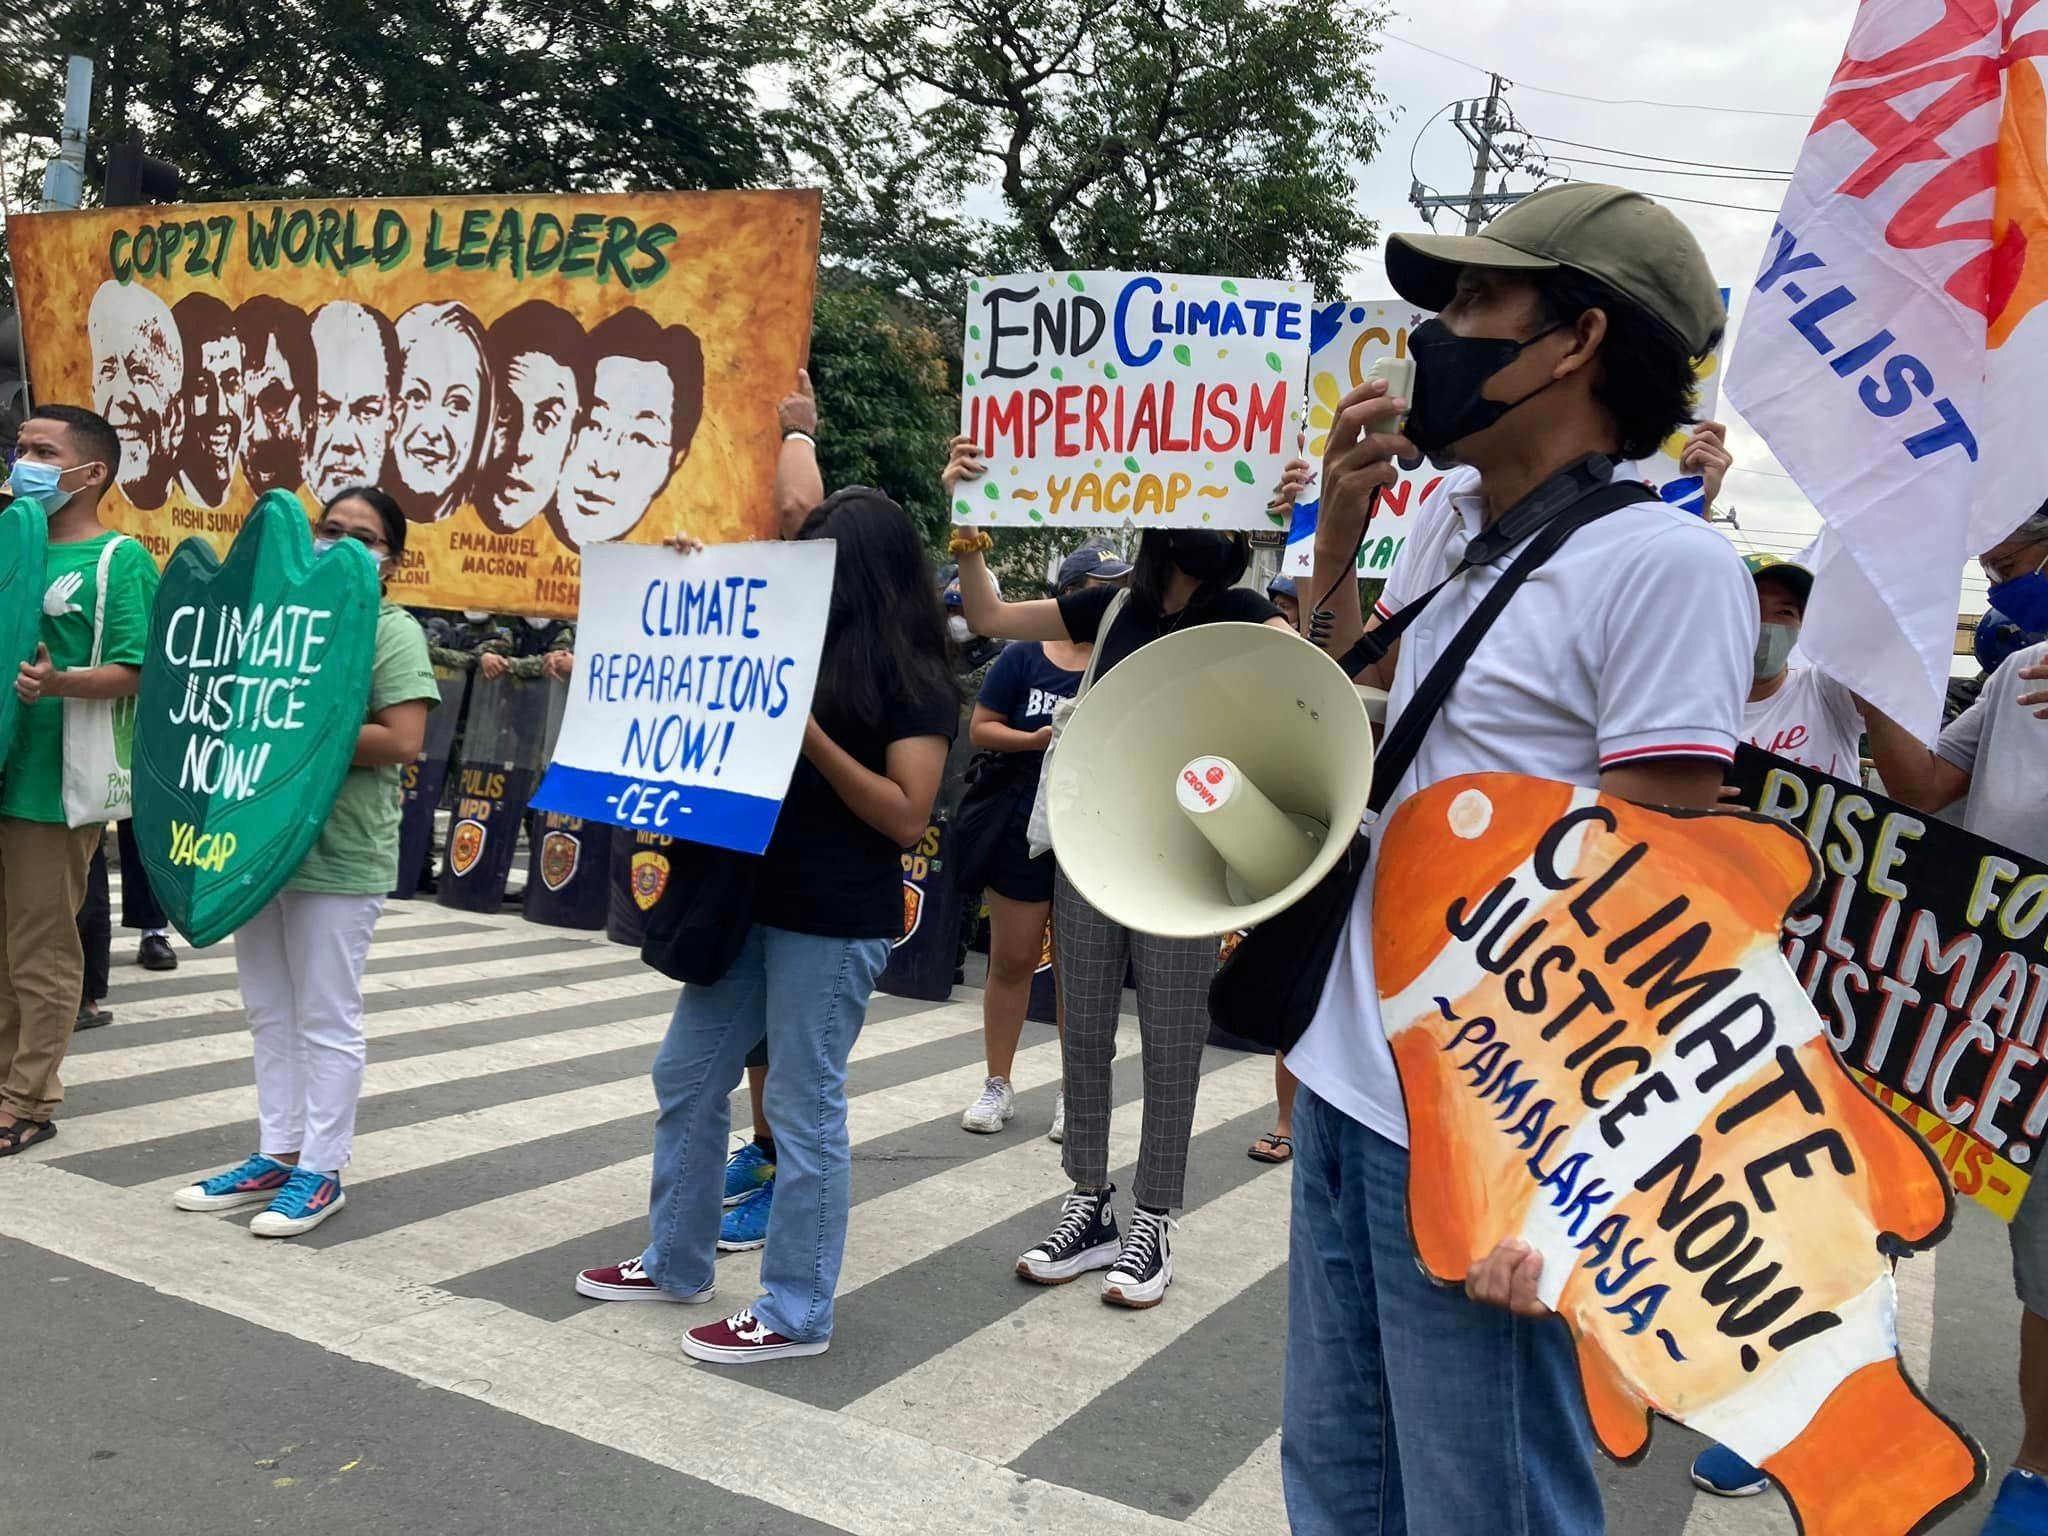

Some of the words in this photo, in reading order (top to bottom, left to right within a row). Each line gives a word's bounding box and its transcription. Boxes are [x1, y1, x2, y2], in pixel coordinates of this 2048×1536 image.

[108, 213, 233, 286] COP27
[246, 210, 408, 273] WORLD
[422, 207, 678, 289] LEADERS
[980, 285, 1106, 379] END
[1113, 276, 1302, 368] CLIMATE
[1755, 222, 1979, 463] Y-LIST
[968, 380, 1288, 460] IMPERIALISM
[172, 507, 204, 530] RISHI
[207, 511, 245, 532] SUNA
[449, 531, 539, 558] EMMANUEL
[461, 555, 528, 579] MACRON
[165, 604, 332, 675] CLIMATE
[640, 575, 768, 640] CLIMATE
[168, 674, 312, 733] JUSTICE
[587, 651, 796, 720] REPARATIONS
[180, 740, 274, 801] NOW!
[621, 711, 738, 777] NOW!
[458, 799, 492, 821] MPD
[460, 769, 506, 799] PULIS
[168, 820, 238, 874] YACAP
[1965, 855, 2048, 952] FO
[1784, 876, 2048, 1058] LIMAT
[1533, 806, 1857, 1213] CLIMATE
[1446, 877, 1680, 1149] JUSTICE
[1634, 1133, 1843, 1373] NOW!
